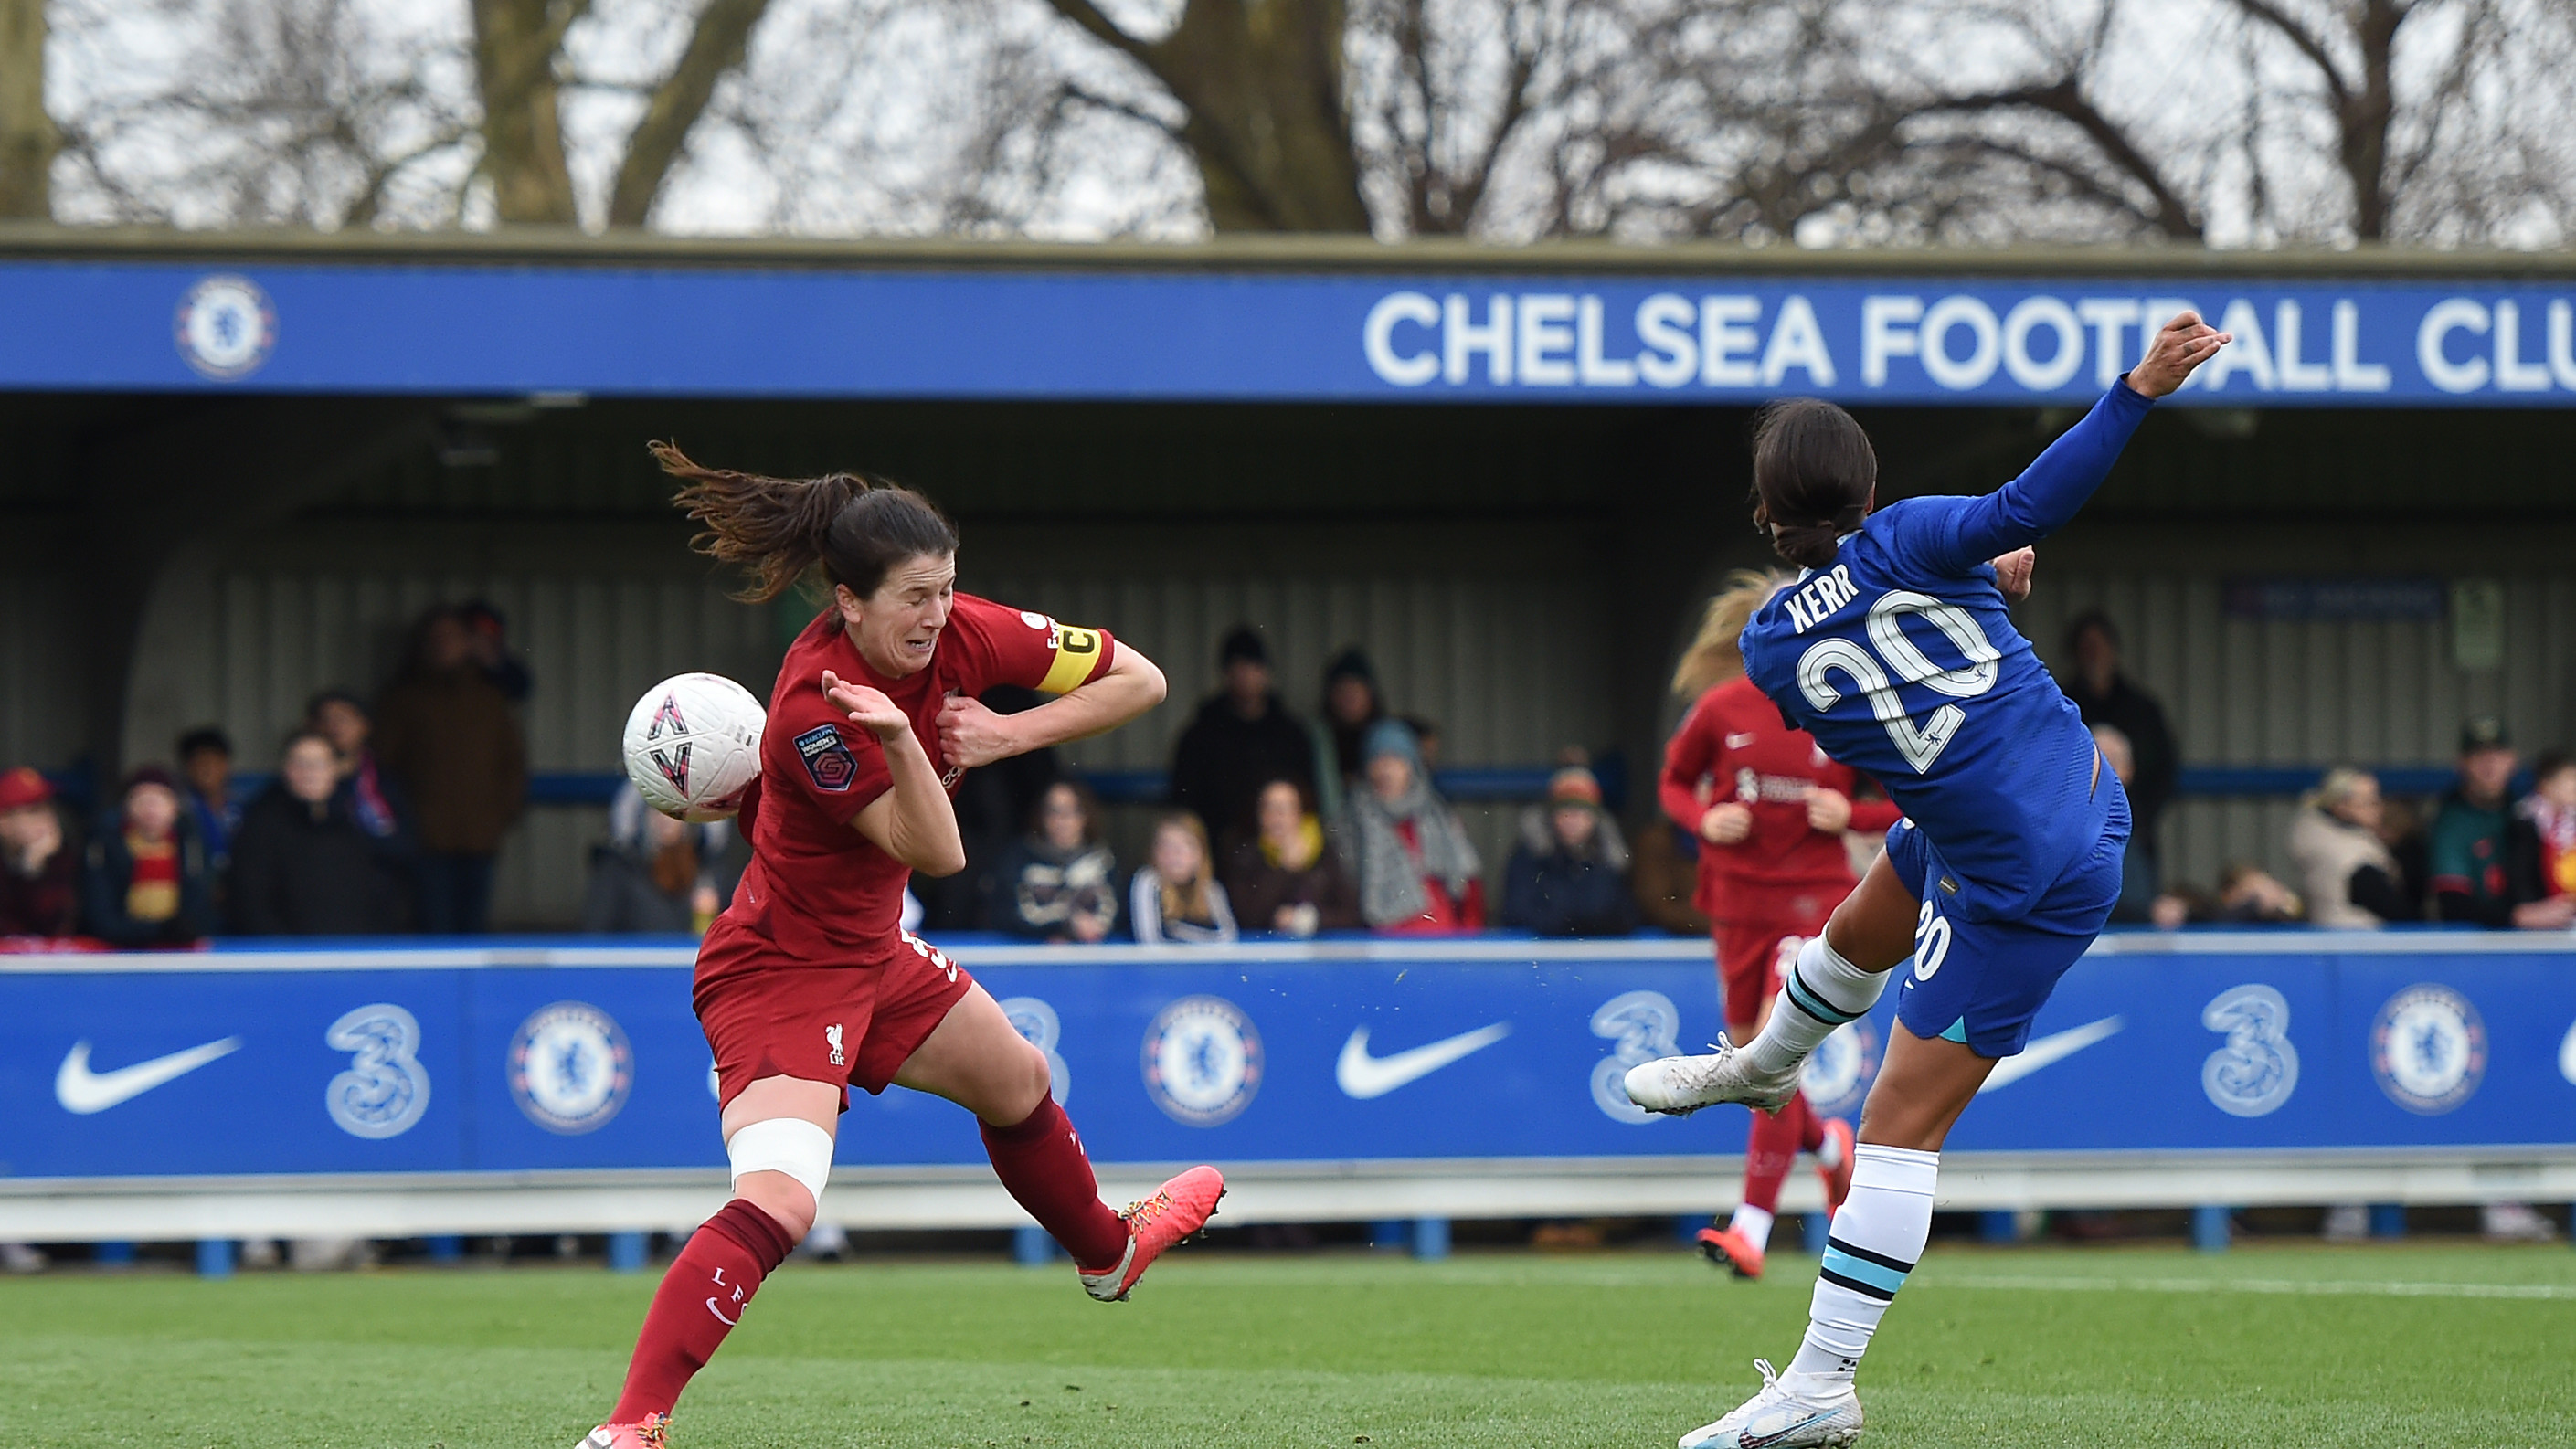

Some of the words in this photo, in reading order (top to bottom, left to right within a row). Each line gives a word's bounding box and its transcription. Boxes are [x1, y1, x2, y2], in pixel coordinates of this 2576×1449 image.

[1363, 291, 1837, 388] CHELSEA
[1063, 630, 1095, 653] C
[1784, 564, 1860, 634] KERR
[1797, 589, 2001, 775] 20
[326, 1003, 431, 1139] 3
[2201, 983, 2299, 1117] 3
